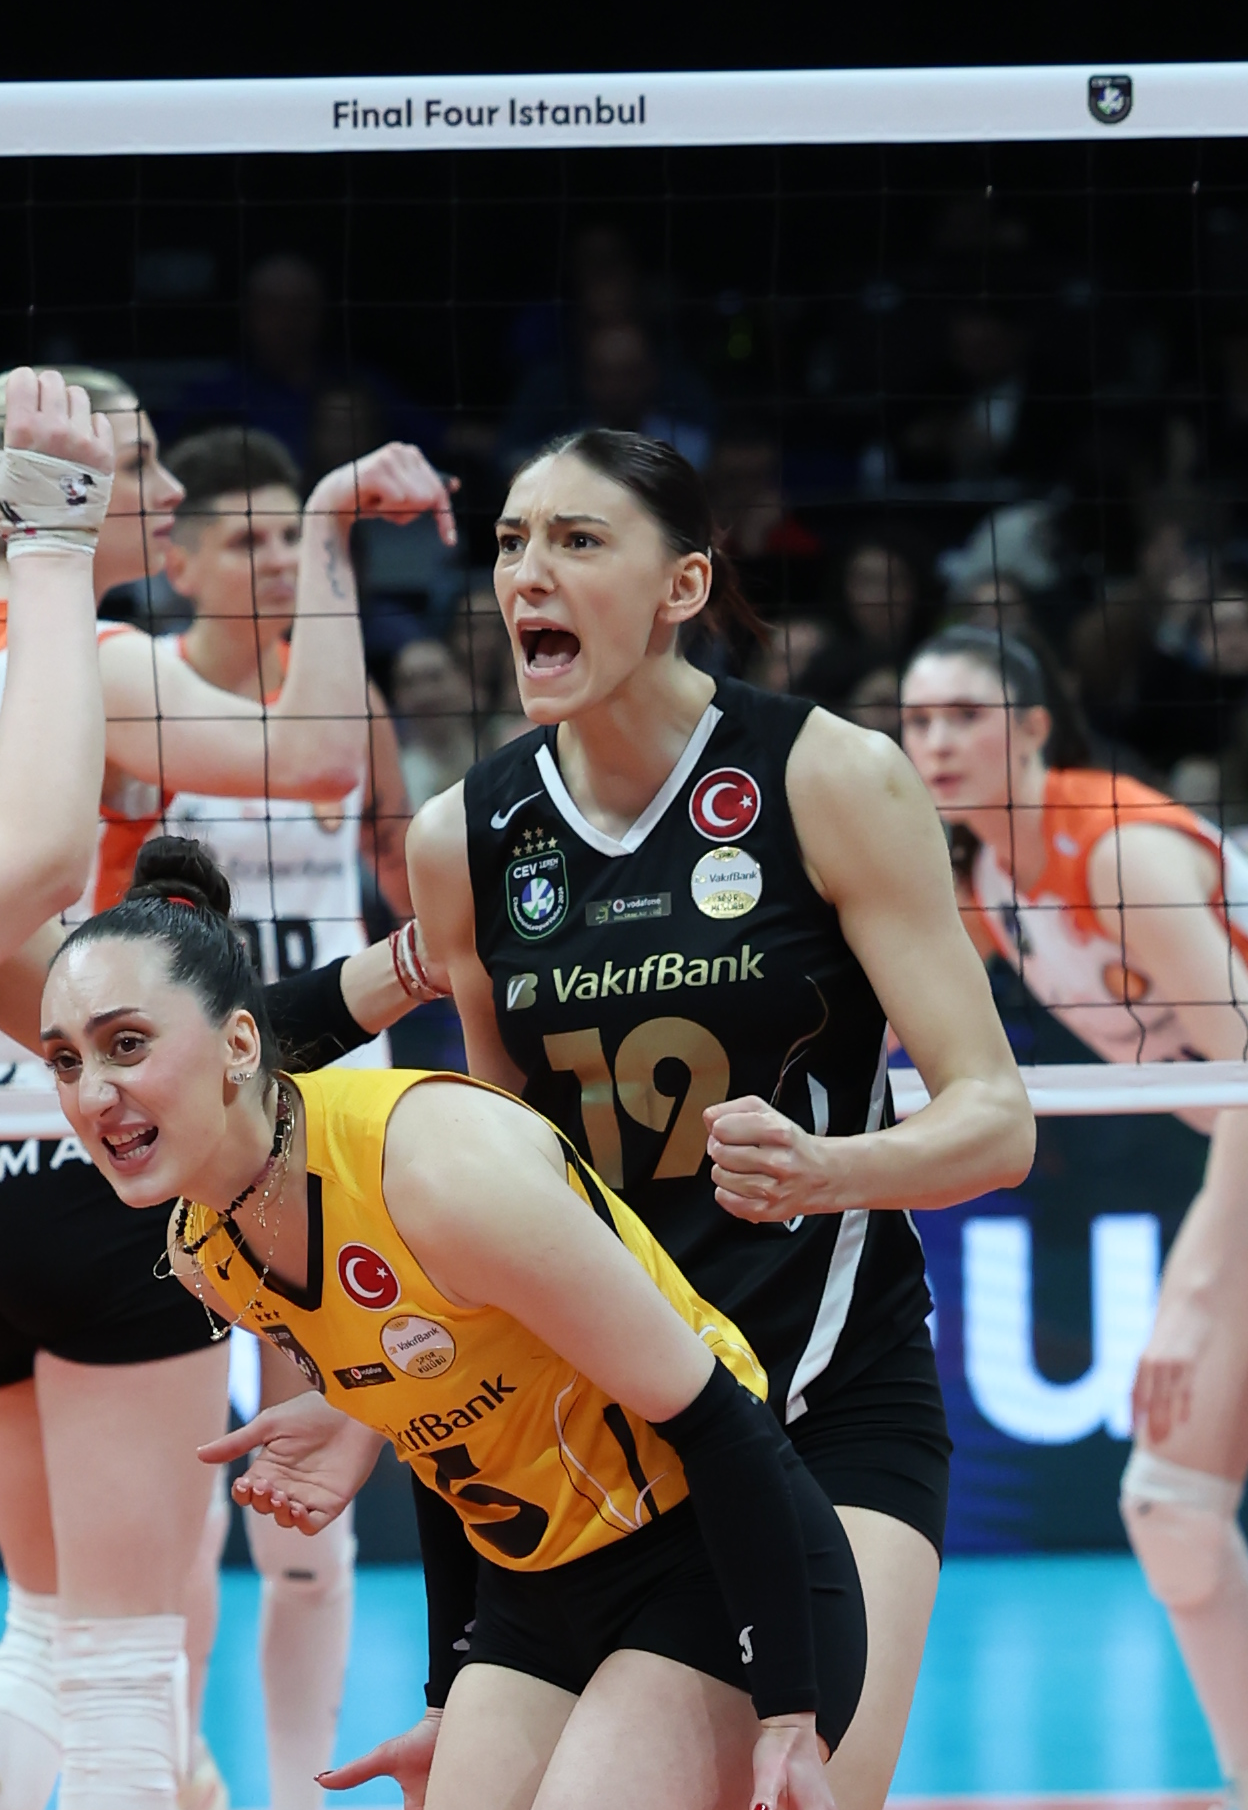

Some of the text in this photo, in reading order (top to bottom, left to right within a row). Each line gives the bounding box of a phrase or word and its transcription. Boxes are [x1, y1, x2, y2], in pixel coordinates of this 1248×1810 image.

[333, 95, 646, 129] Final Four Istanbul
[513, 861, 538, 879] CEV
[626, 898, 661, 909] vodafone
[552, 944, 765, 1003] VakıfBank
[542, 1016, 731, 1190] 19
